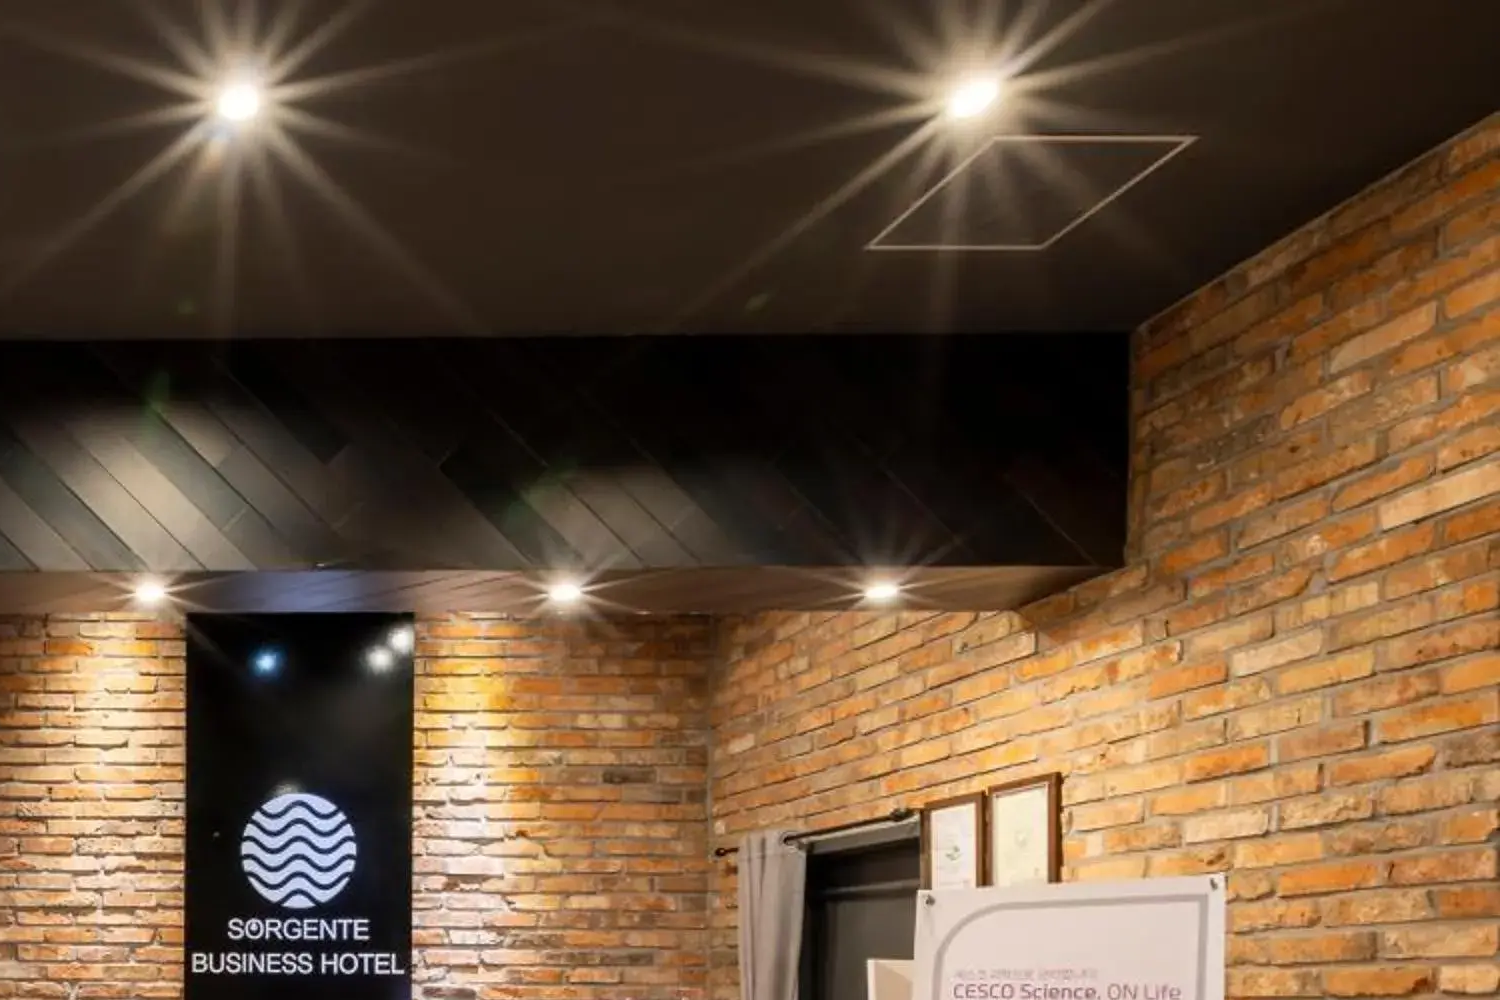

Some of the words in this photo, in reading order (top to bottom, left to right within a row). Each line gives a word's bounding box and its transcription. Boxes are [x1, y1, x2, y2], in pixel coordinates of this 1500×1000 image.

[227, 918, 371, 940] SORGENTE
[191, 953, 313, 974] BUSINESS
[321, 953, 405, 974] HOTEL
[953, 983, 1014, 999] CESCO
[1107, 983, 1139, 1000] ON
[1144, 983, 1182, 1000] Life
